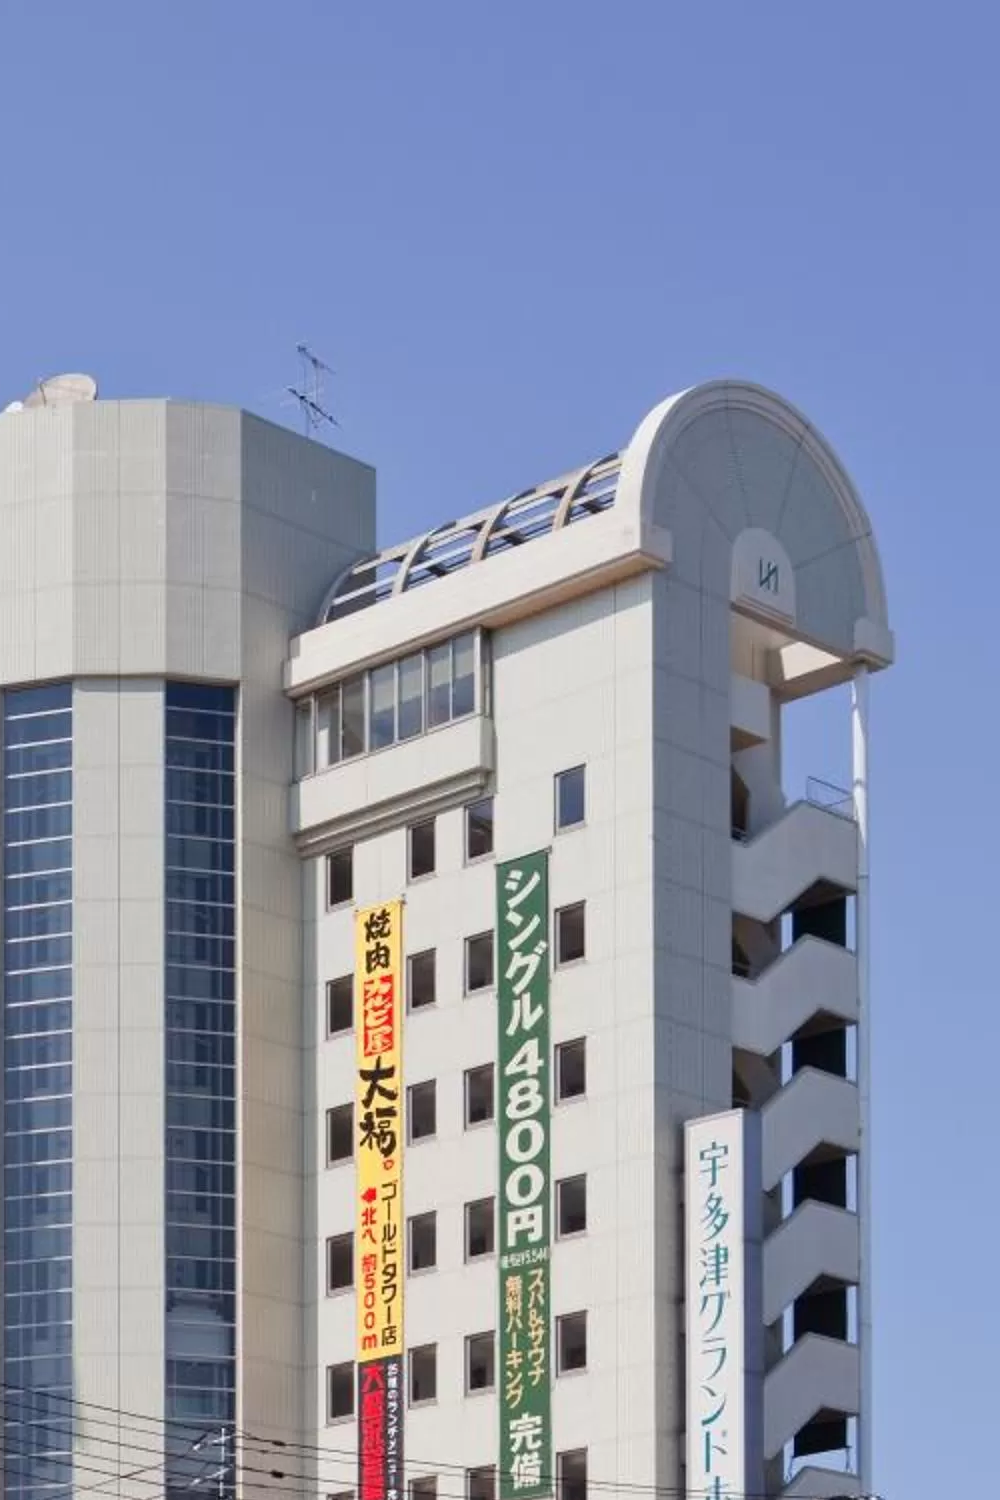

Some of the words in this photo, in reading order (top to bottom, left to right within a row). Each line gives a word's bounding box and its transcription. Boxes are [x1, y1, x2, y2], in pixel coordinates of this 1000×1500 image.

[363, 908, 392, 974] 焼肉
[381, 1178, 398, 1347] ゴールドタワー店
[509, 1411, 544, 1490] 完備
